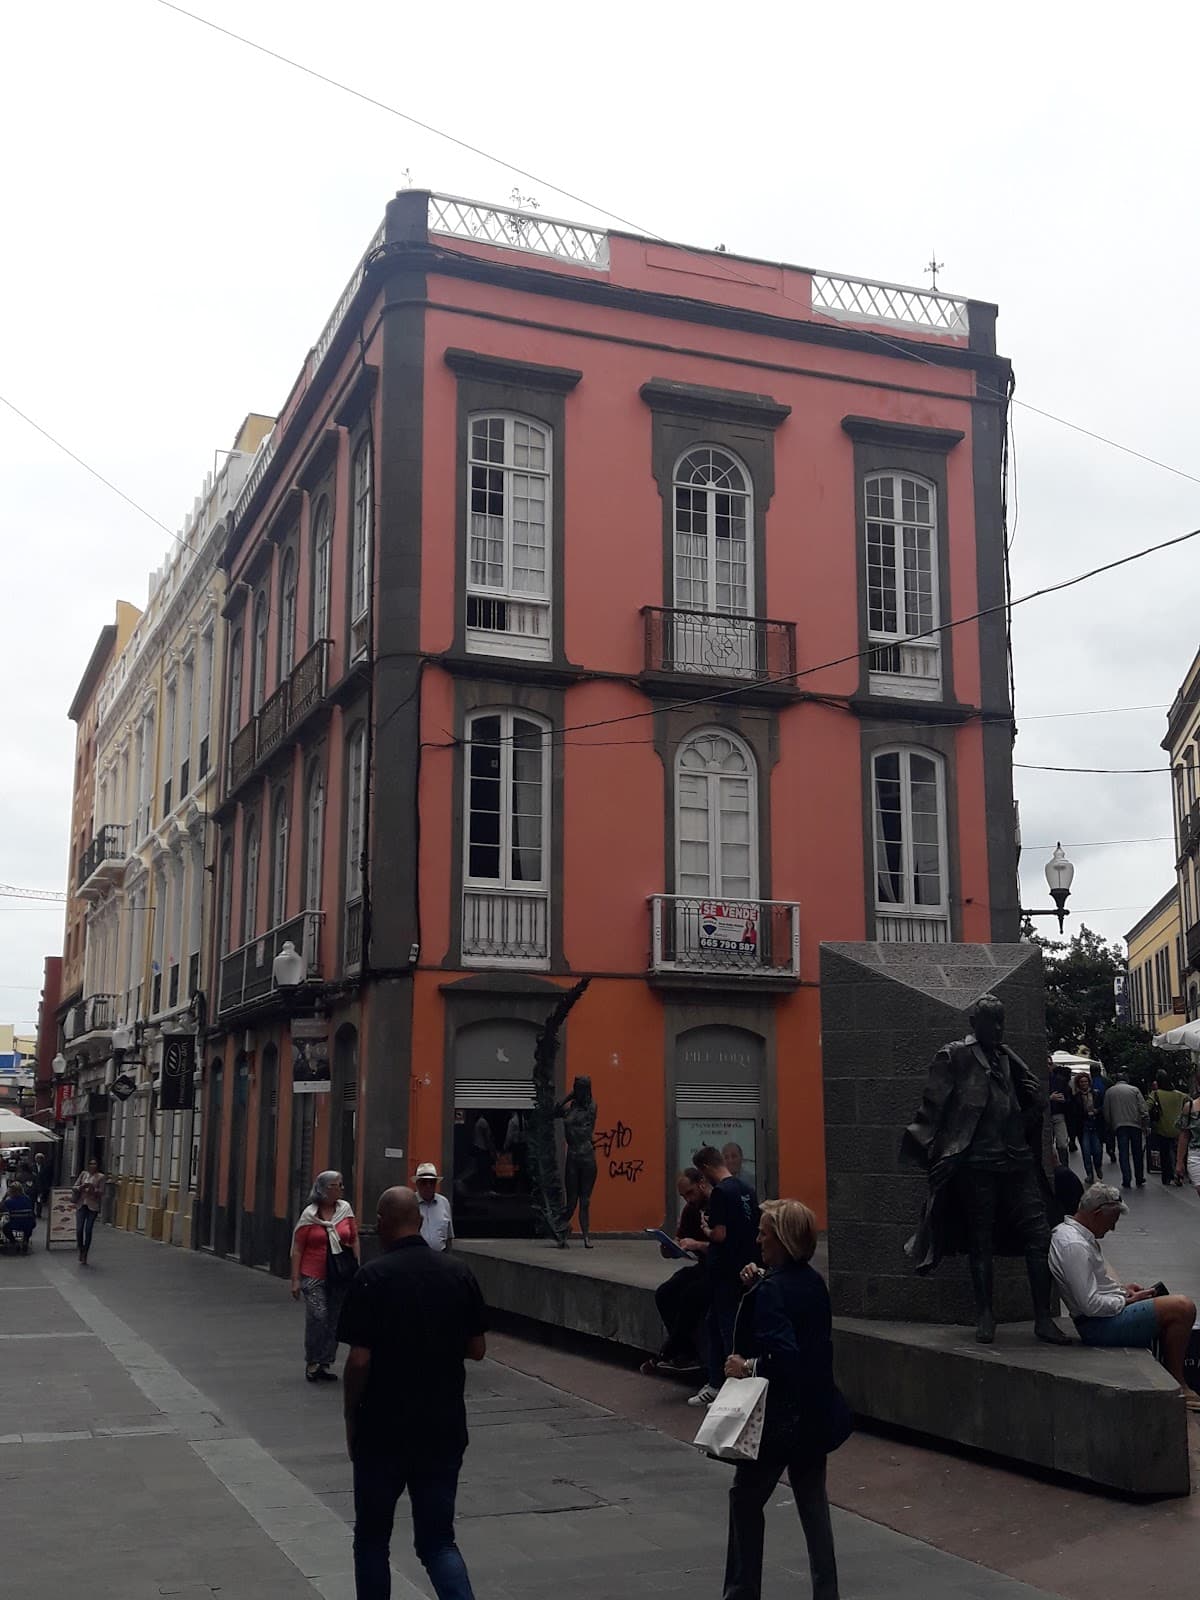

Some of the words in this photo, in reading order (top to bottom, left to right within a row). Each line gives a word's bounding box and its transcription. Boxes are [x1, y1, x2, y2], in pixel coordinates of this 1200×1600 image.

[704, 904, 717, 916] SE
[722, 906, 757, 920] VENDE
[701, 938, 718, 947] 665
